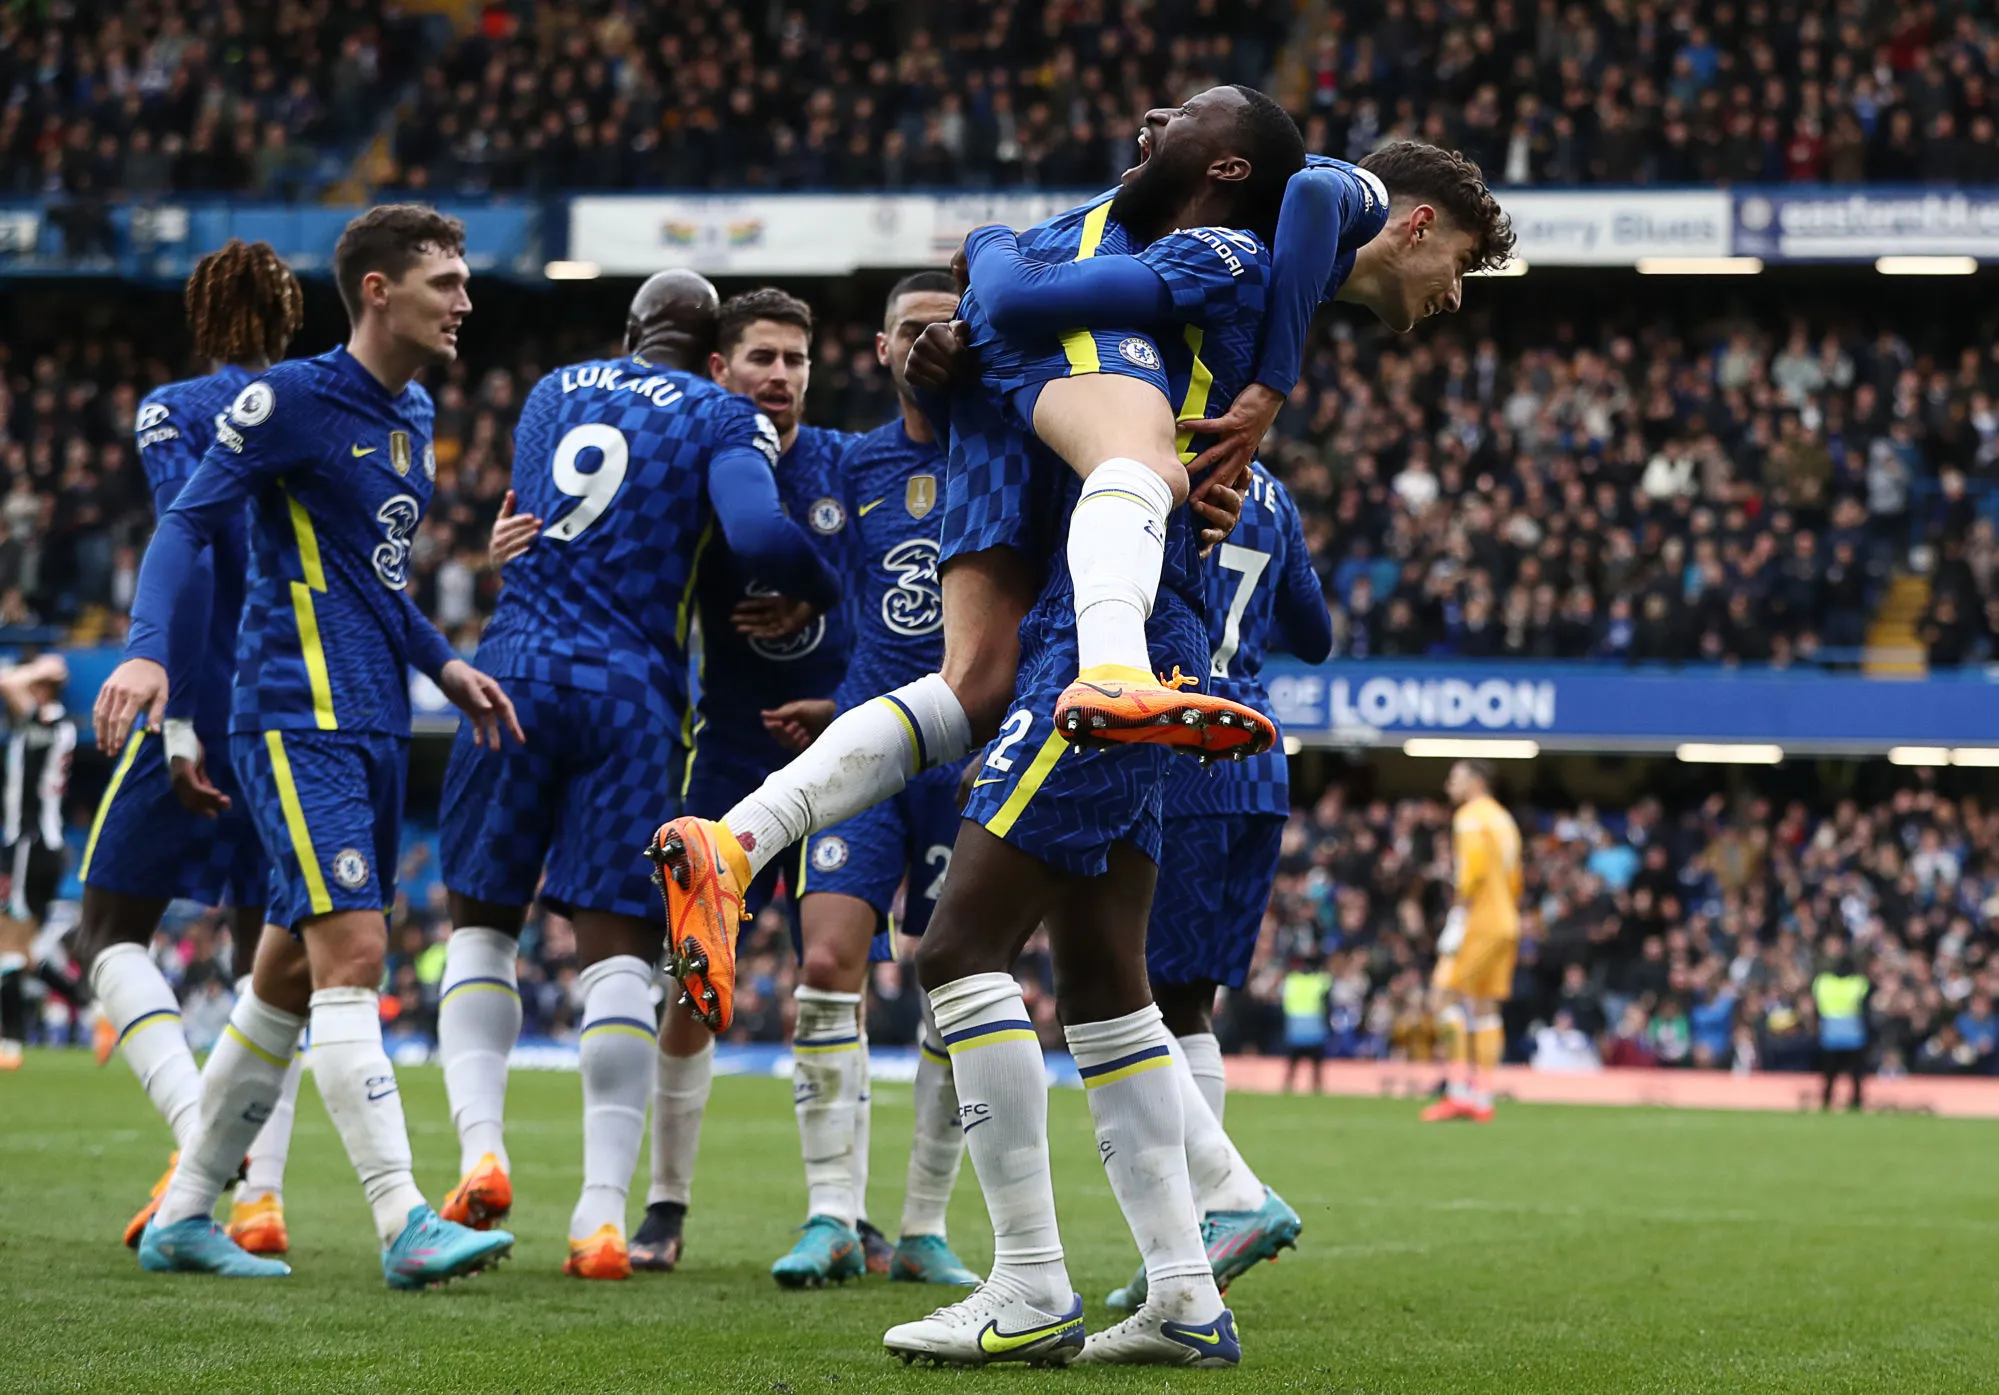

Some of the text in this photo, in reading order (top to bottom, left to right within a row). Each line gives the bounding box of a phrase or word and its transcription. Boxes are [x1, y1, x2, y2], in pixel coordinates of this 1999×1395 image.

[561, 366, 684, 407] LUKAKU
[542, 423, 629, 541] 9
[1244, 474, 1277, 514] TÉ
[1209, 542, 1271, 678] 7
[1329, 676, 1555, 728] LONDON
[985, 708, 1034, 772] 2
